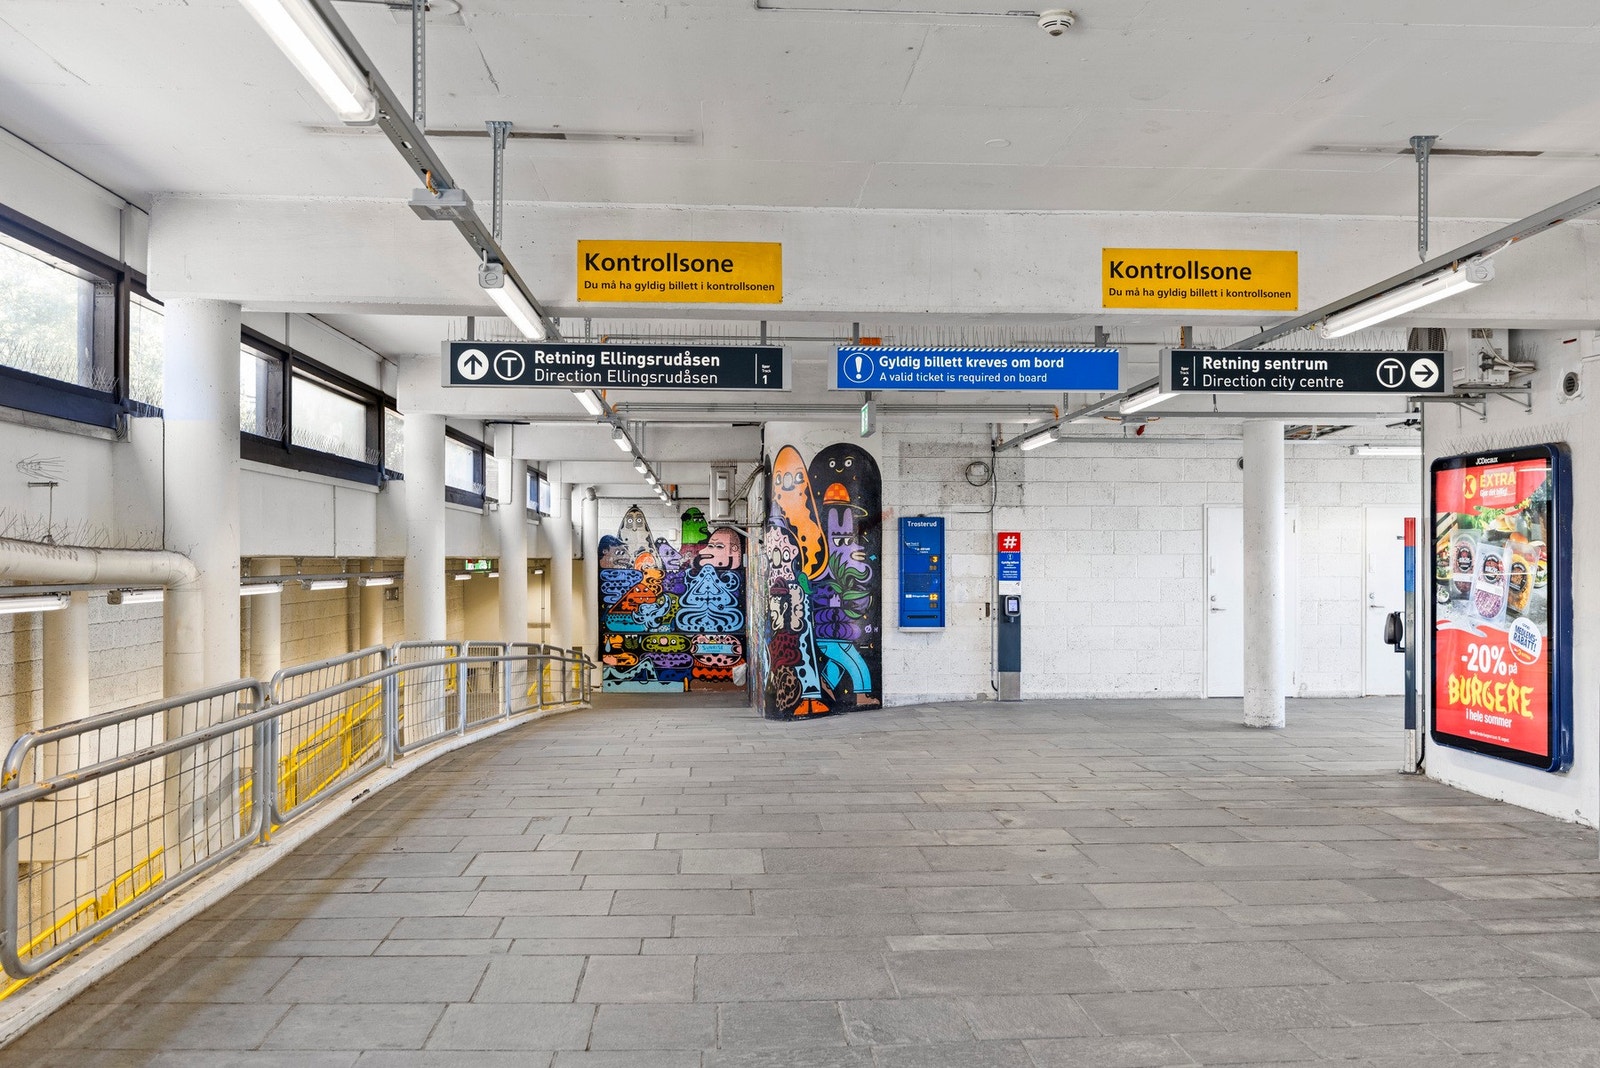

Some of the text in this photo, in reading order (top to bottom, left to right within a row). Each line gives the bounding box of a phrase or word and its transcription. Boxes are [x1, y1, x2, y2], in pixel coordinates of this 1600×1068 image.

[585, 252, 734, 272] Kontrollsone
[1110, 260, 1252, 280] Kontrollsone
[584, 280, 775, 292] Du må ha gyldig billett i kontrollsonen
[1109, 287, 1291, 298] Du må ha gyldig billett i kontrollsonen
[535, 350, 720, 368] Retning Ellingsrudåsen
[879, 356, 1064, 370] Gyldig billett kreves om bord
[1203, 356, 1328, 372] Retning sentrum
[535, 368, 718, 386] Direction Ellingsrudåsen
[763, 375, 767, 384] 1
[880, 373, 887, 381] A
[890, 372, 912, 382] valid
[916, 373, 944, 382] ticket
[947, 373, 955, 382] is
[958, 373, 1000, 384] required
[1019, 373, 1047, 382] board
[1183, 377, 1189, 386] 2
[1203, 374, 1344, 390] Direction city centre
[1476, 457, 1498, 465] JCDecaux
[1480, 472, 1516, 488] EXTRA
[1513, 632, 1537, 652] RABATT!
[1461, 643, 1507, 676] -20%
[1508, 662, 1517, 675] på
[1448, 672, 1534, 720] BURGERE
[1466, 708, 1512, 728] i hele sommer
